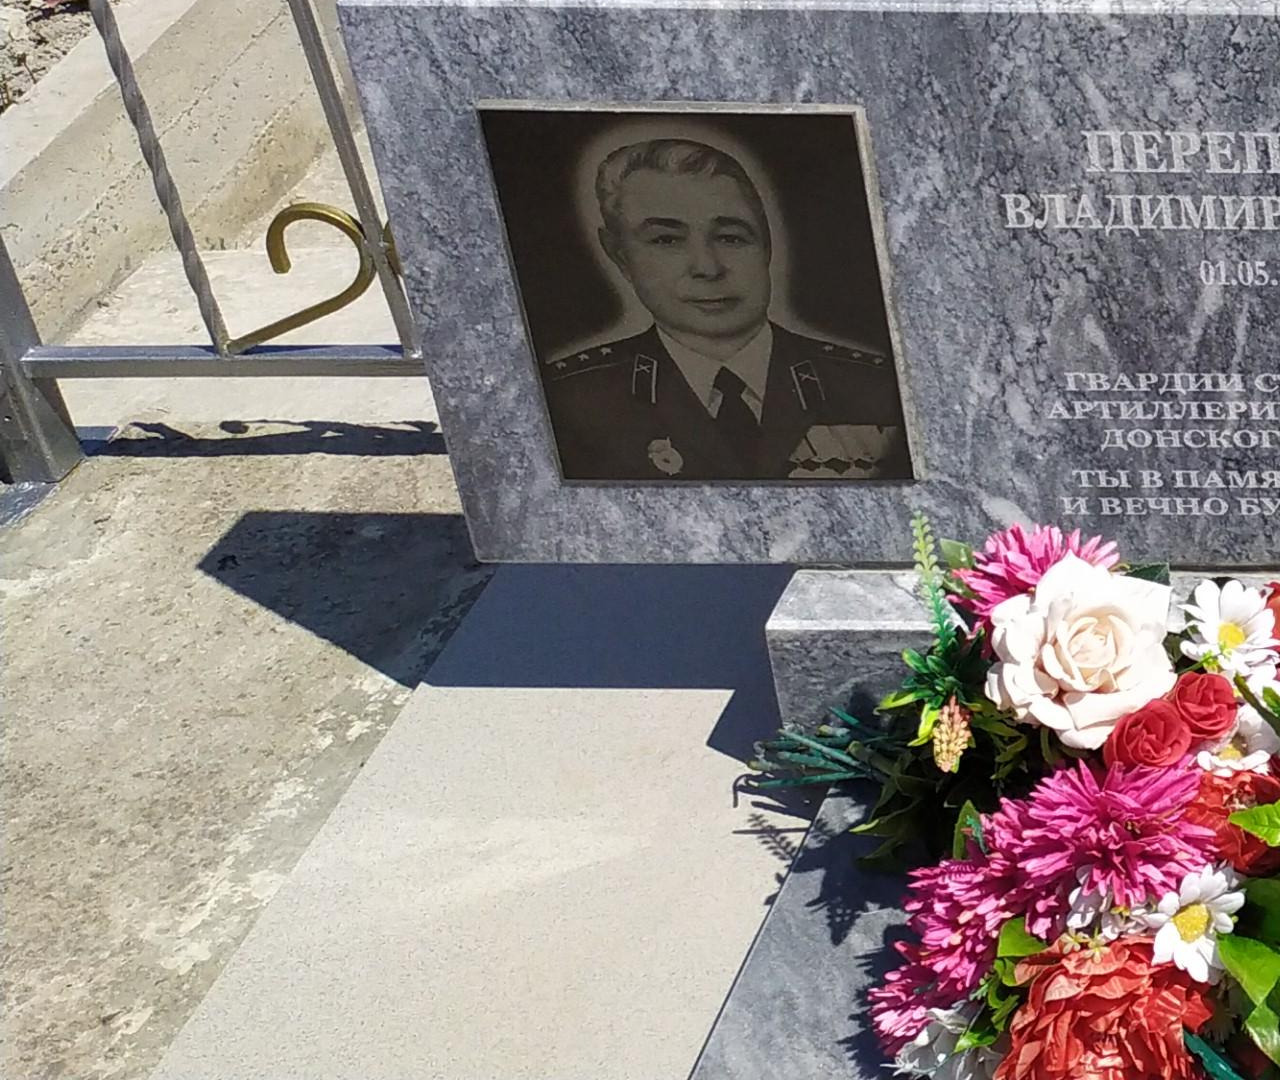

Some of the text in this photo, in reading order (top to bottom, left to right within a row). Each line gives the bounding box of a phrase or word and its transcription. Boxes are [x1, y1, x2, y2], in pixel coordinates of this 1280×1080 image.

[1199, 260, 1279, 287] 01.05.
[1064, 372, 1246, 395] ГВАРДИИ
[1072, 470, 1132, 488] ТЫ
[1141, 470, 1164, 488] В
[1062, 497, 1091, 515] И
[1100, 497, 1230, 516] ВЕЧНО
